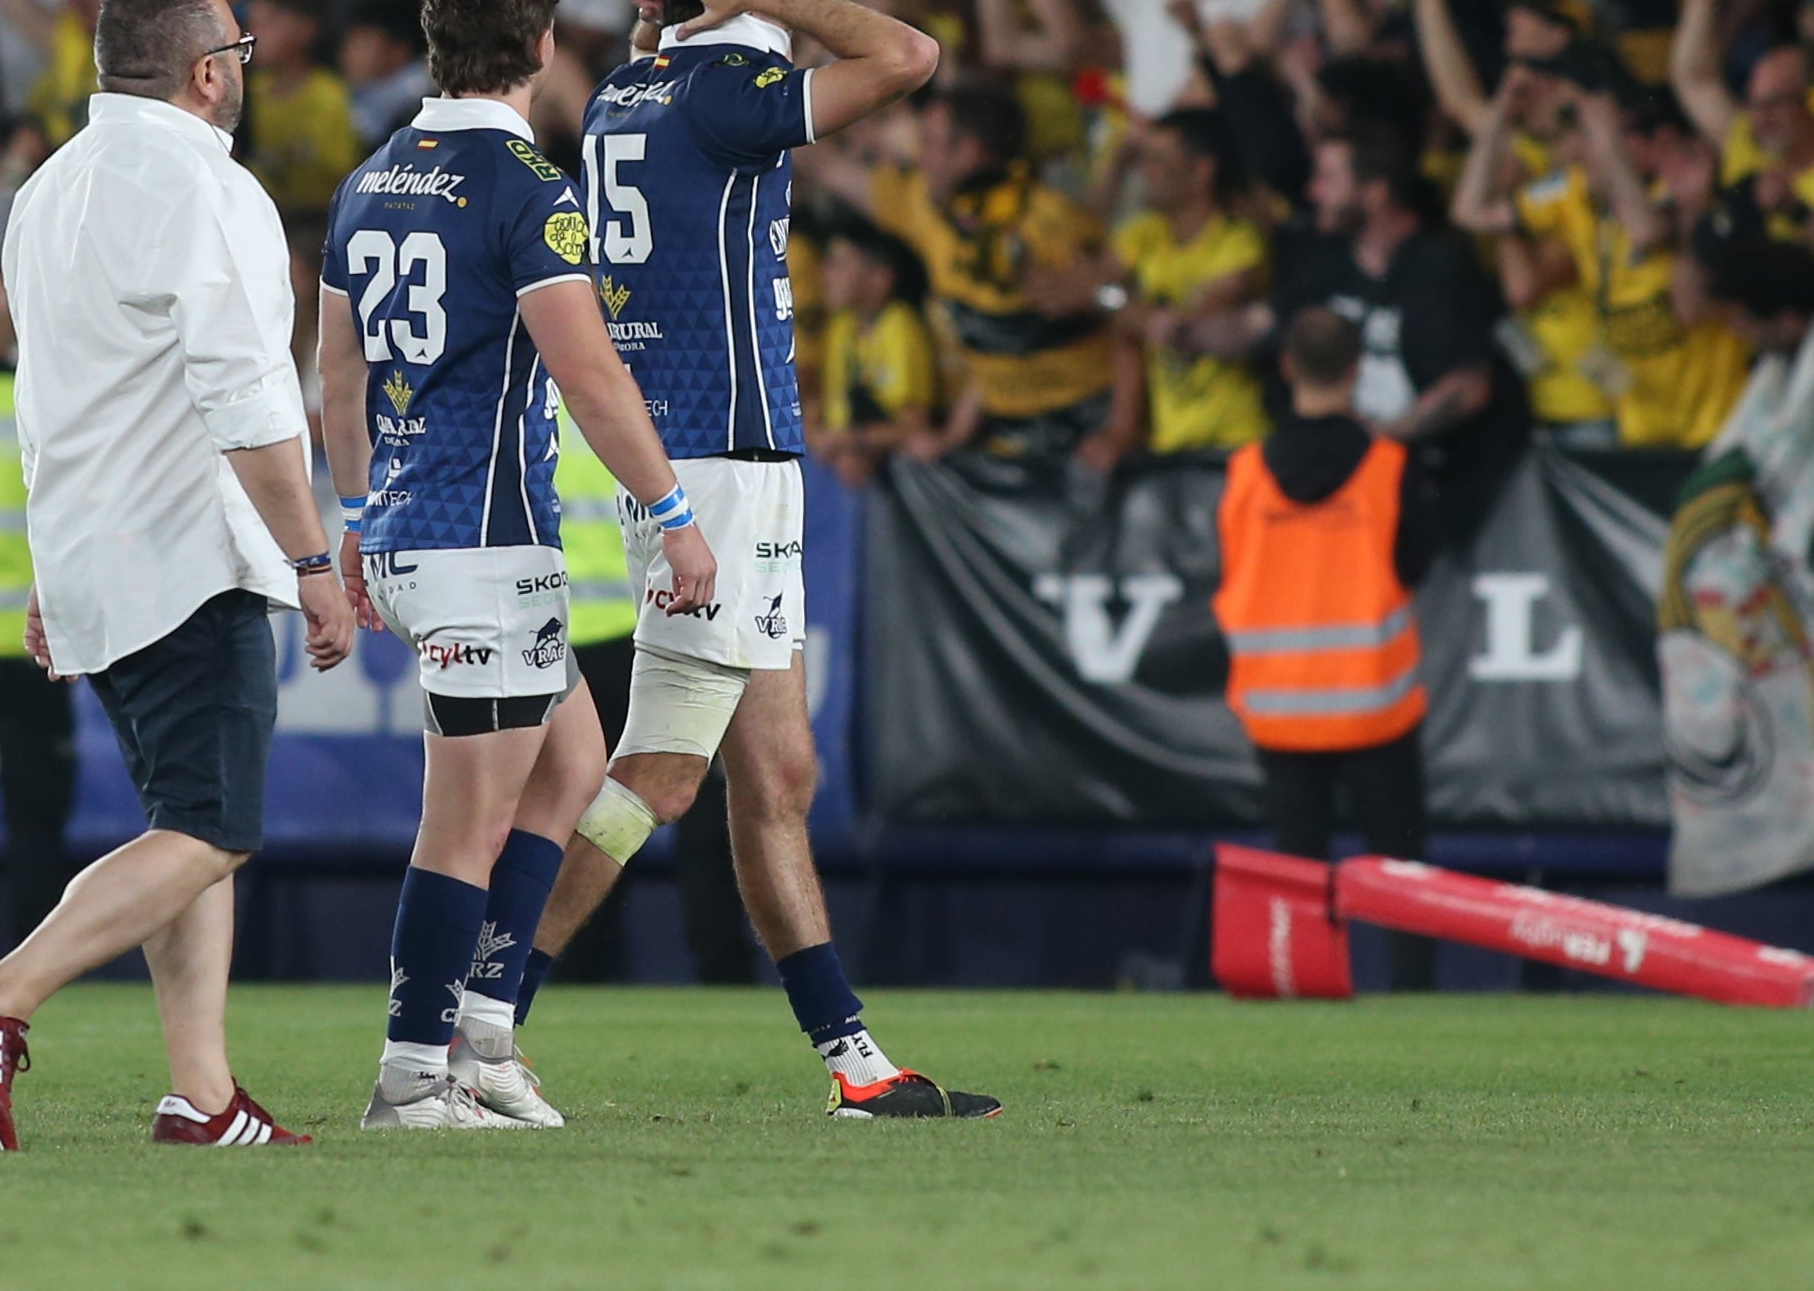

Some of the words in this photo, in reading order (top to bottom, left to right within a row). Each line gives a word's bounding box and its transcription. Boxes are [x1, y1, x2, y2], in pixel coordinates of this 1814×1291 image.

[355, 163, 465, 203] meléndez
[582, 134, 653, 265] 15
[346, 230, 448, 365] 23
